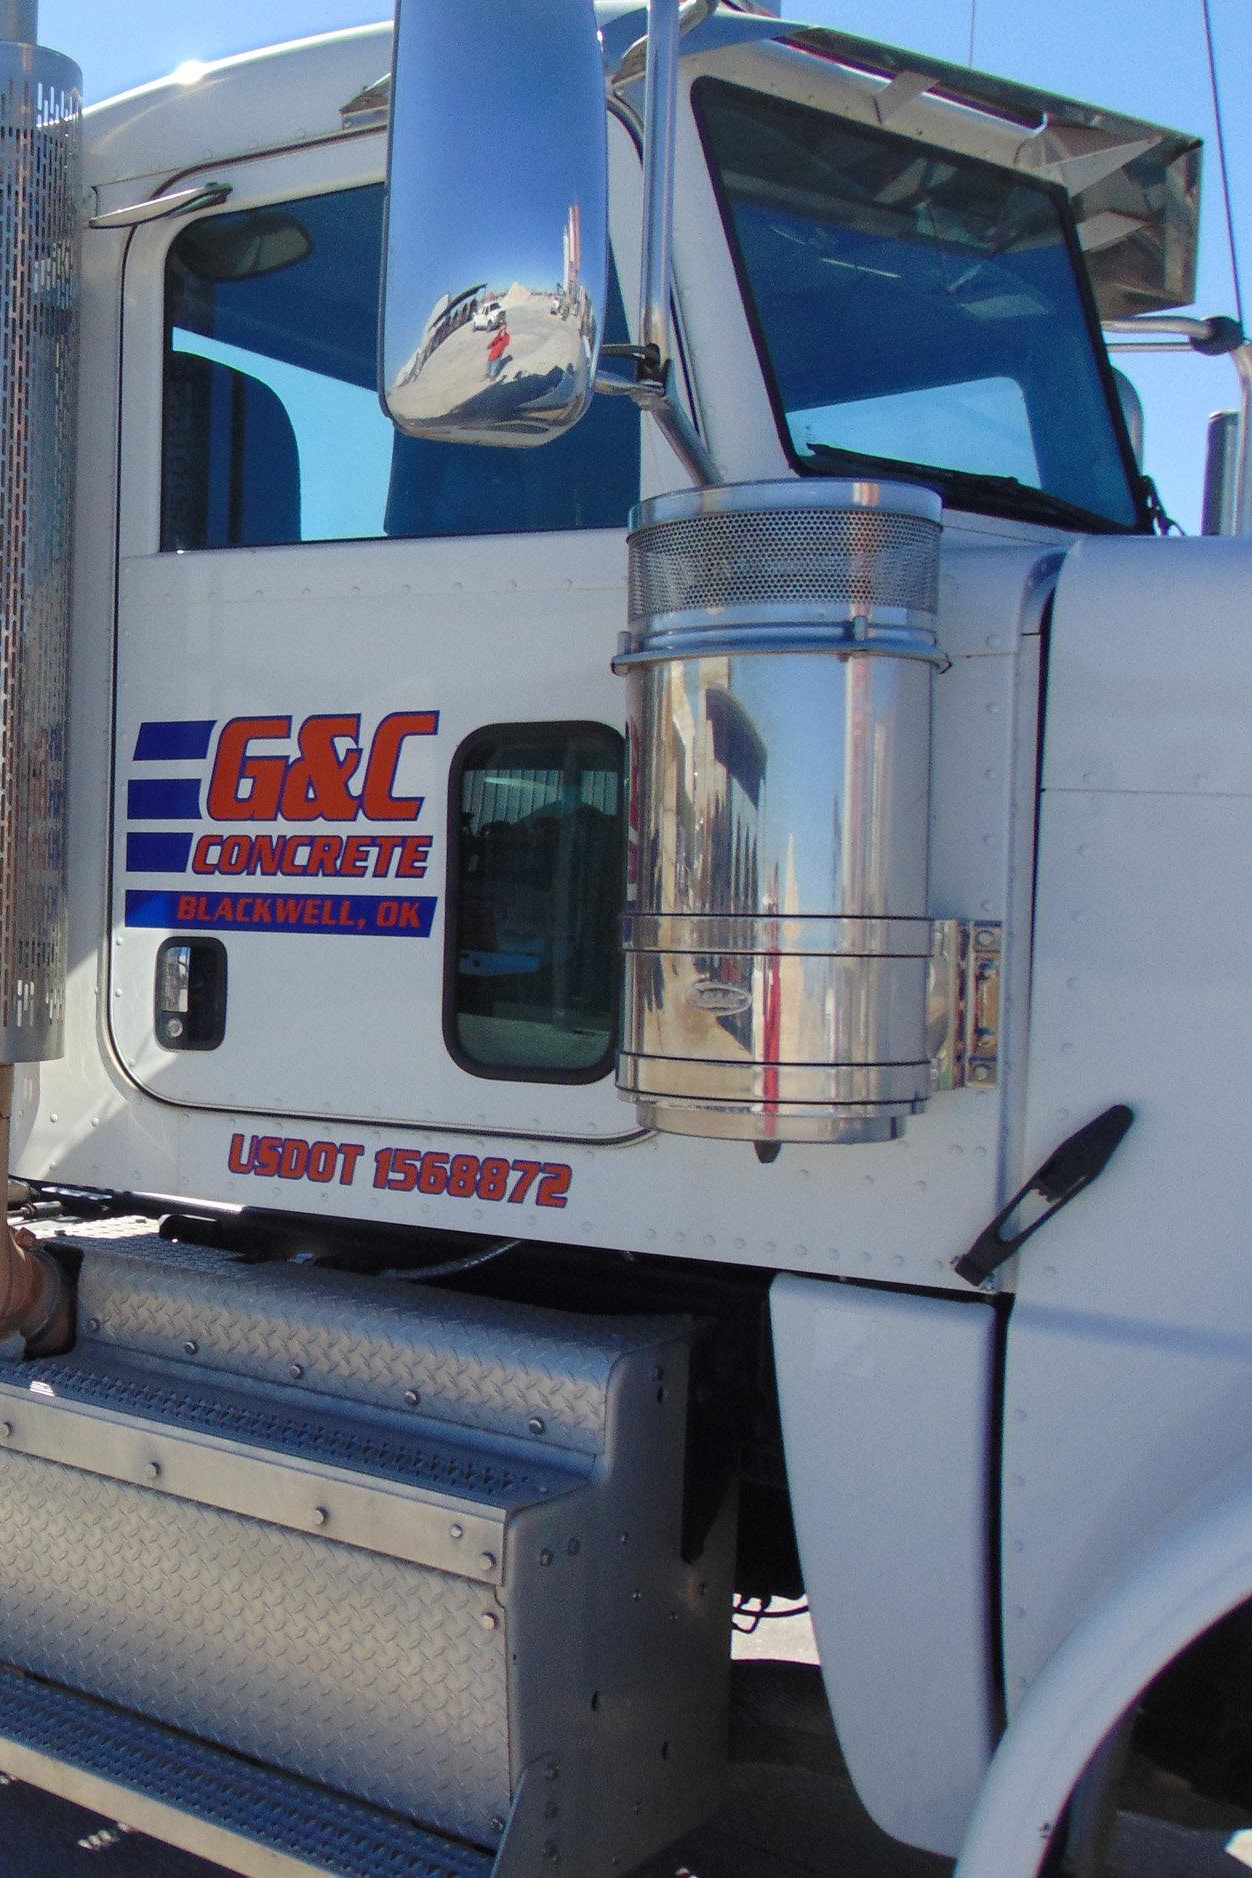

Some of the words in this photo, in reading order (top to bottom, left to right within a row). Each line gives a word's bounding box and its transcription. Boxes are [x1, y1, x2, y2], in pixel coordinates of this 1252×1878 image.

[207, 710, 440, 821] G&C
[192, 835, 433, 878] CONCRETE
[177, 895, 366, 929] BLACKWELL,
[376, 901, 421, 928] OK
[228, 1133, 365, 1185] USDOT
[373, 1147, 572, 1208] 1568872
